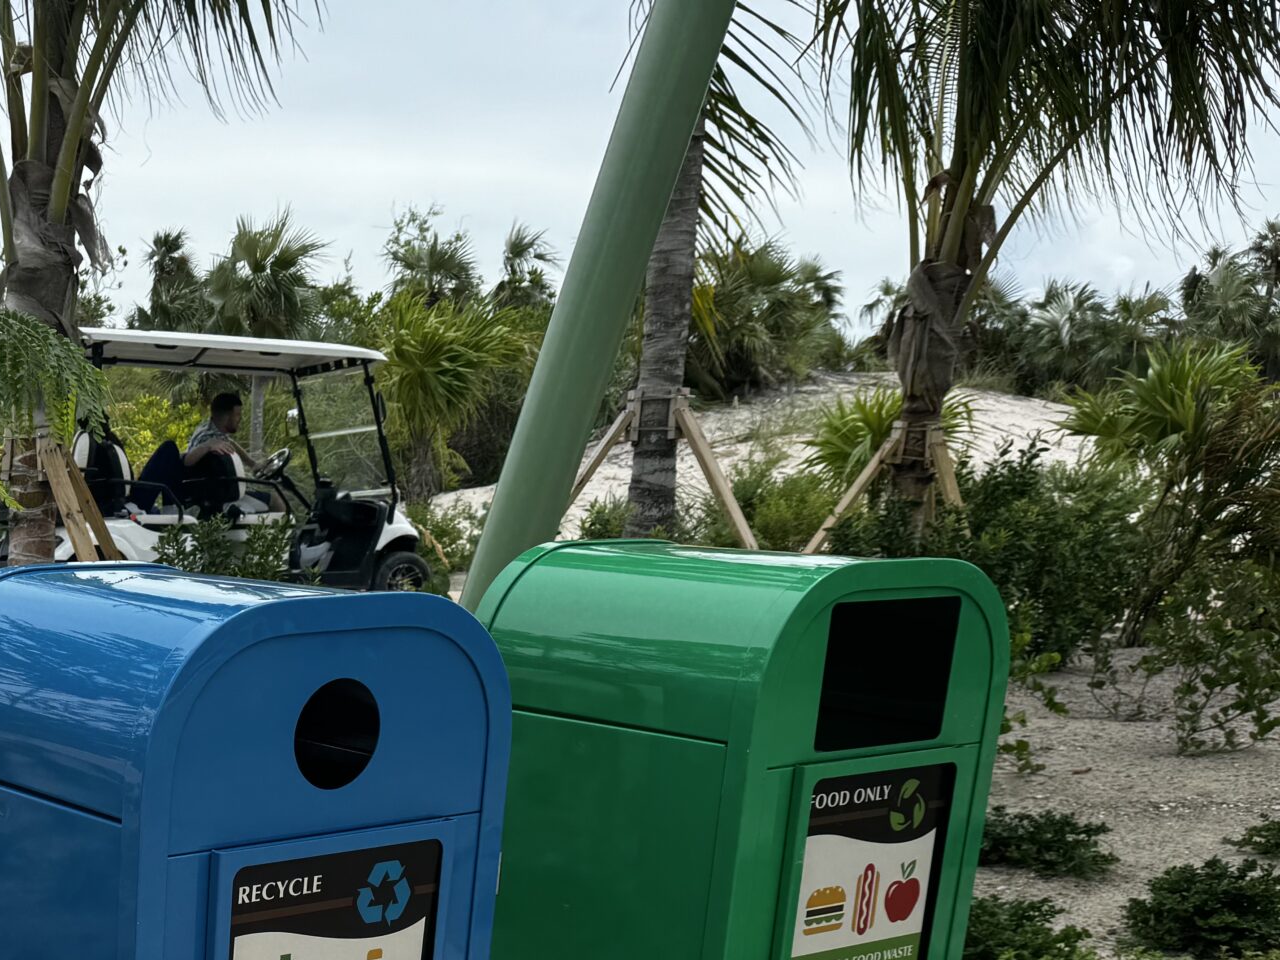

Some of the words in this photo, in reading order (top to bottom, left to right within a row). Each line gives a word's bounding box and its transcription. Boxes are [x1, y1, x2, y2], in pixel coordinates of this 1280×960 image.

[854, 784, 892, 803] ONLY
[237, 875, 322, 904] RECYCLE
[883, 945, 914, 960] WASTE
